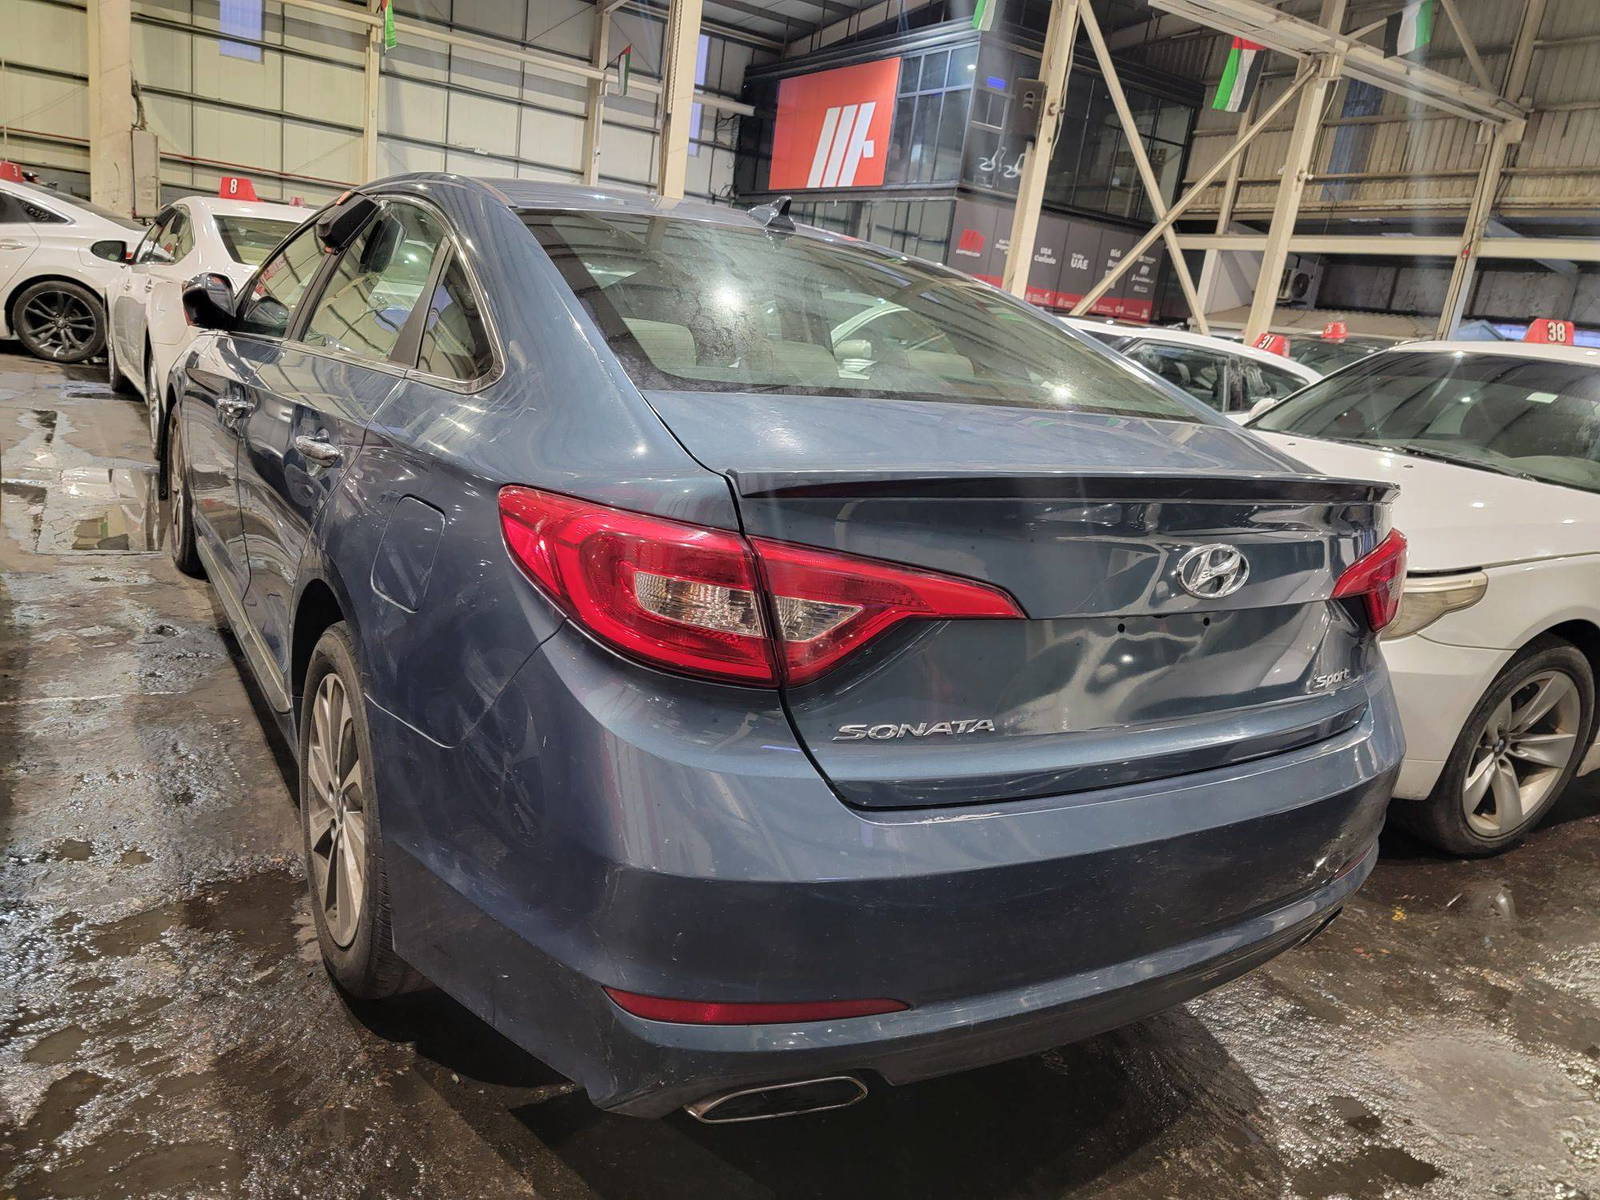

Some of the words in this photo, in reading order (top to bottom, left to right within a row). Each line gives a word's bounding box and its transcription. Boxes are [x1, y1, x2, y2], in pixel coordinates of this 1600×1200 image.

[229, 178, 238, 194] 8
[1070, 258, 1089, 270] UAE
[1547, 321, 1566, 342] 38
[1258, 335, 1275, 350] 31
[1313, 667, 1351, 689] Sport
[832, 718, 996, 741] SONATA
